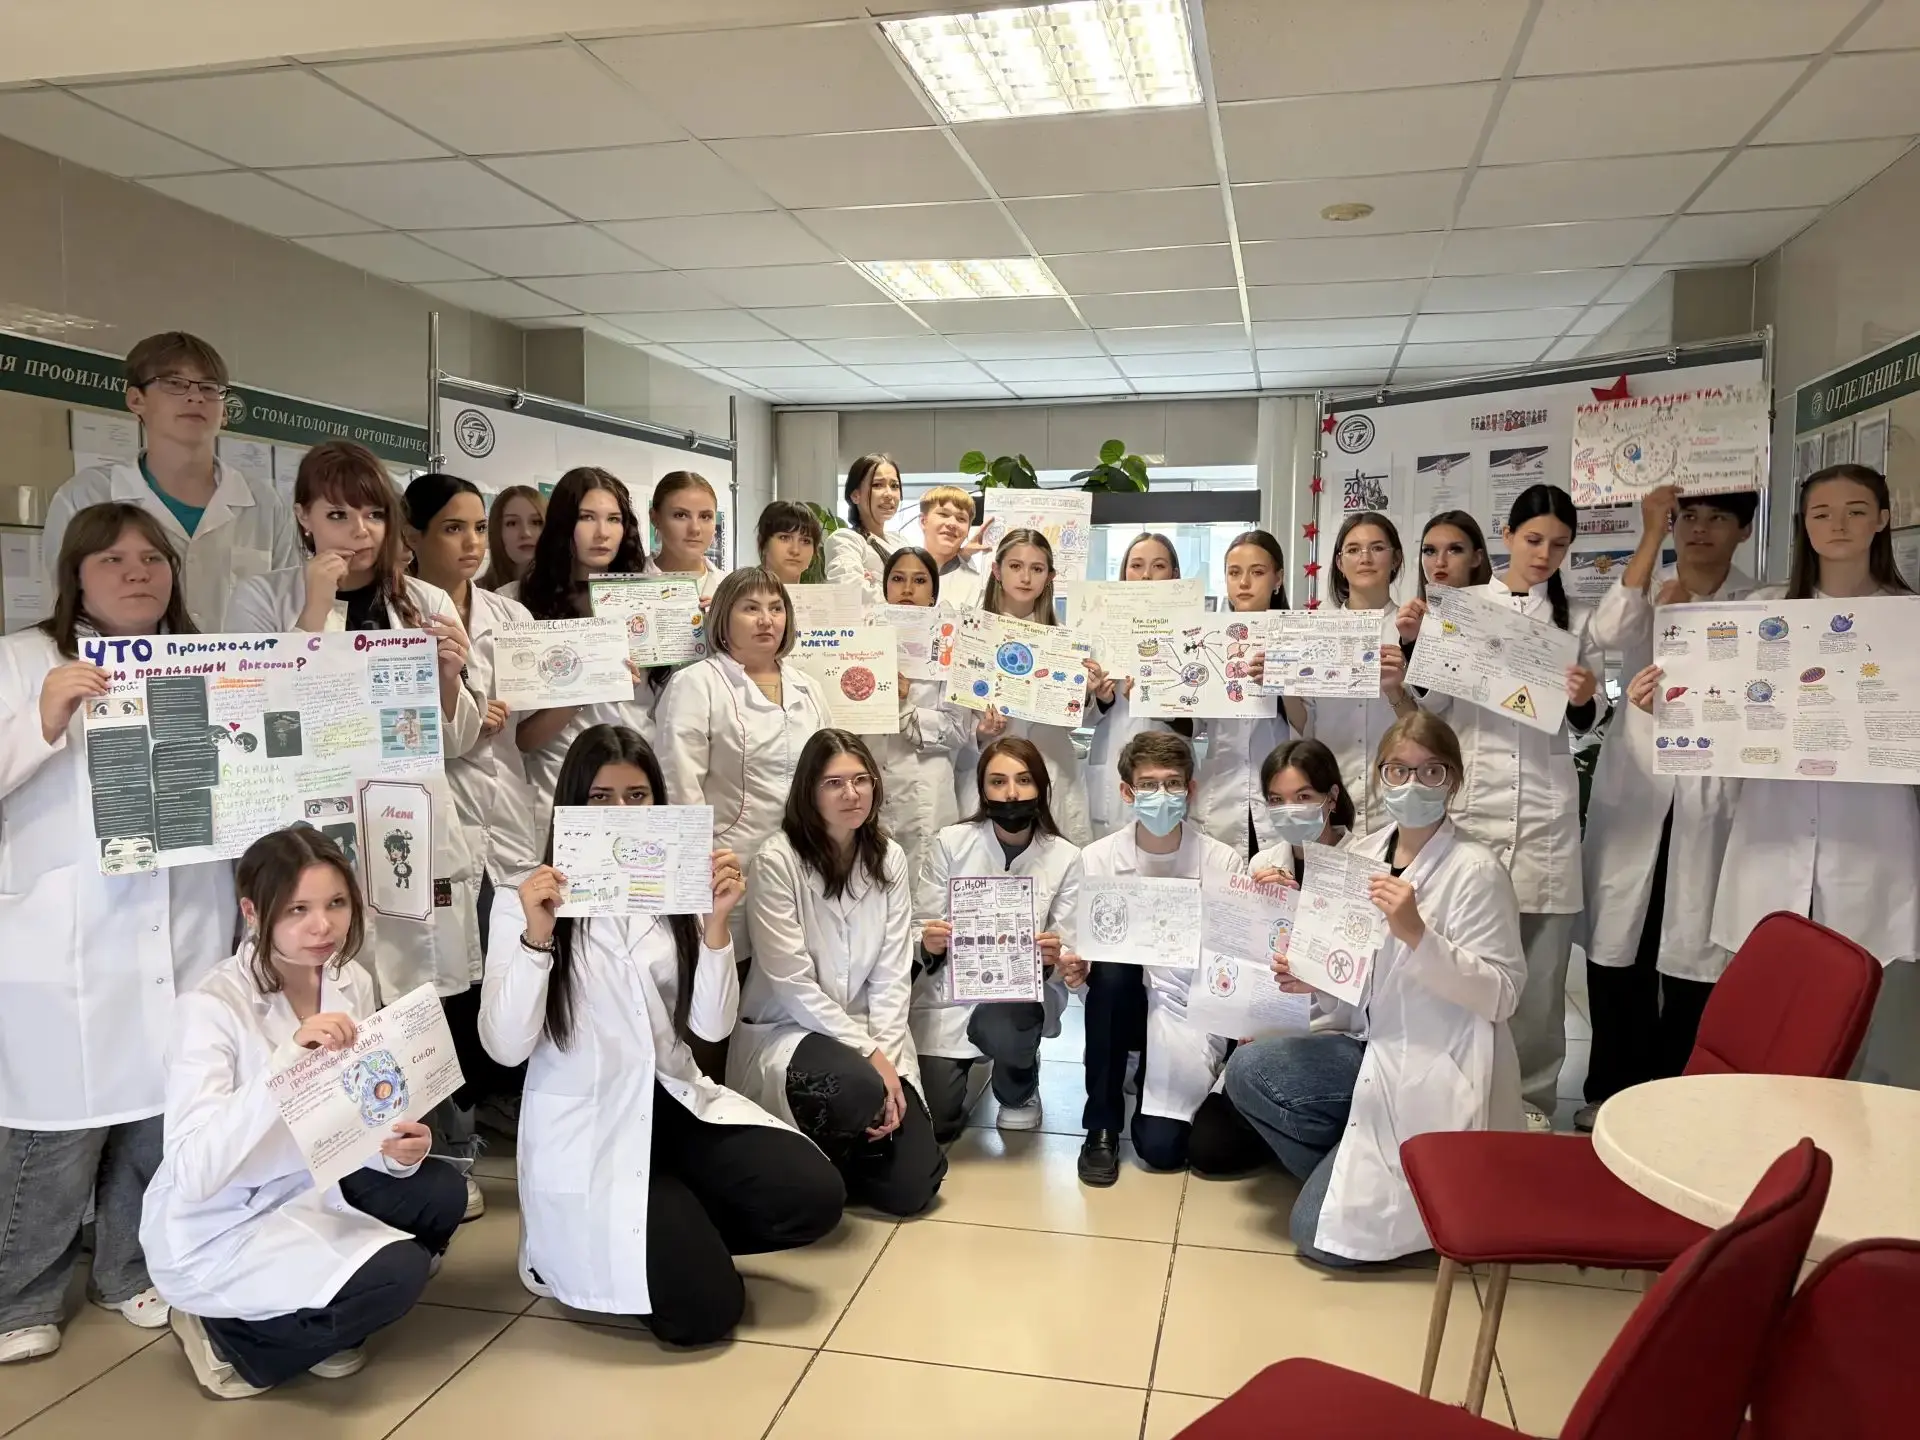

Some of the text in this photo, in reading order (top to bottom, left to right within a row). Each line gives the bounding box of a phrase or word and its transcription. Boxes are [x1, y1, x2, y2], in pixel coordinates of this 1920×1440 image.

[1826, 359, 1903, 412] ОТДЕЛЕНИЕ
[252, 405, 349, 438] СТОМАТОЛОГИЯ
[85, 638, 153, 667] ЧТО
[1229, 874, 1289, 902] ВЛИЯНИЕ
